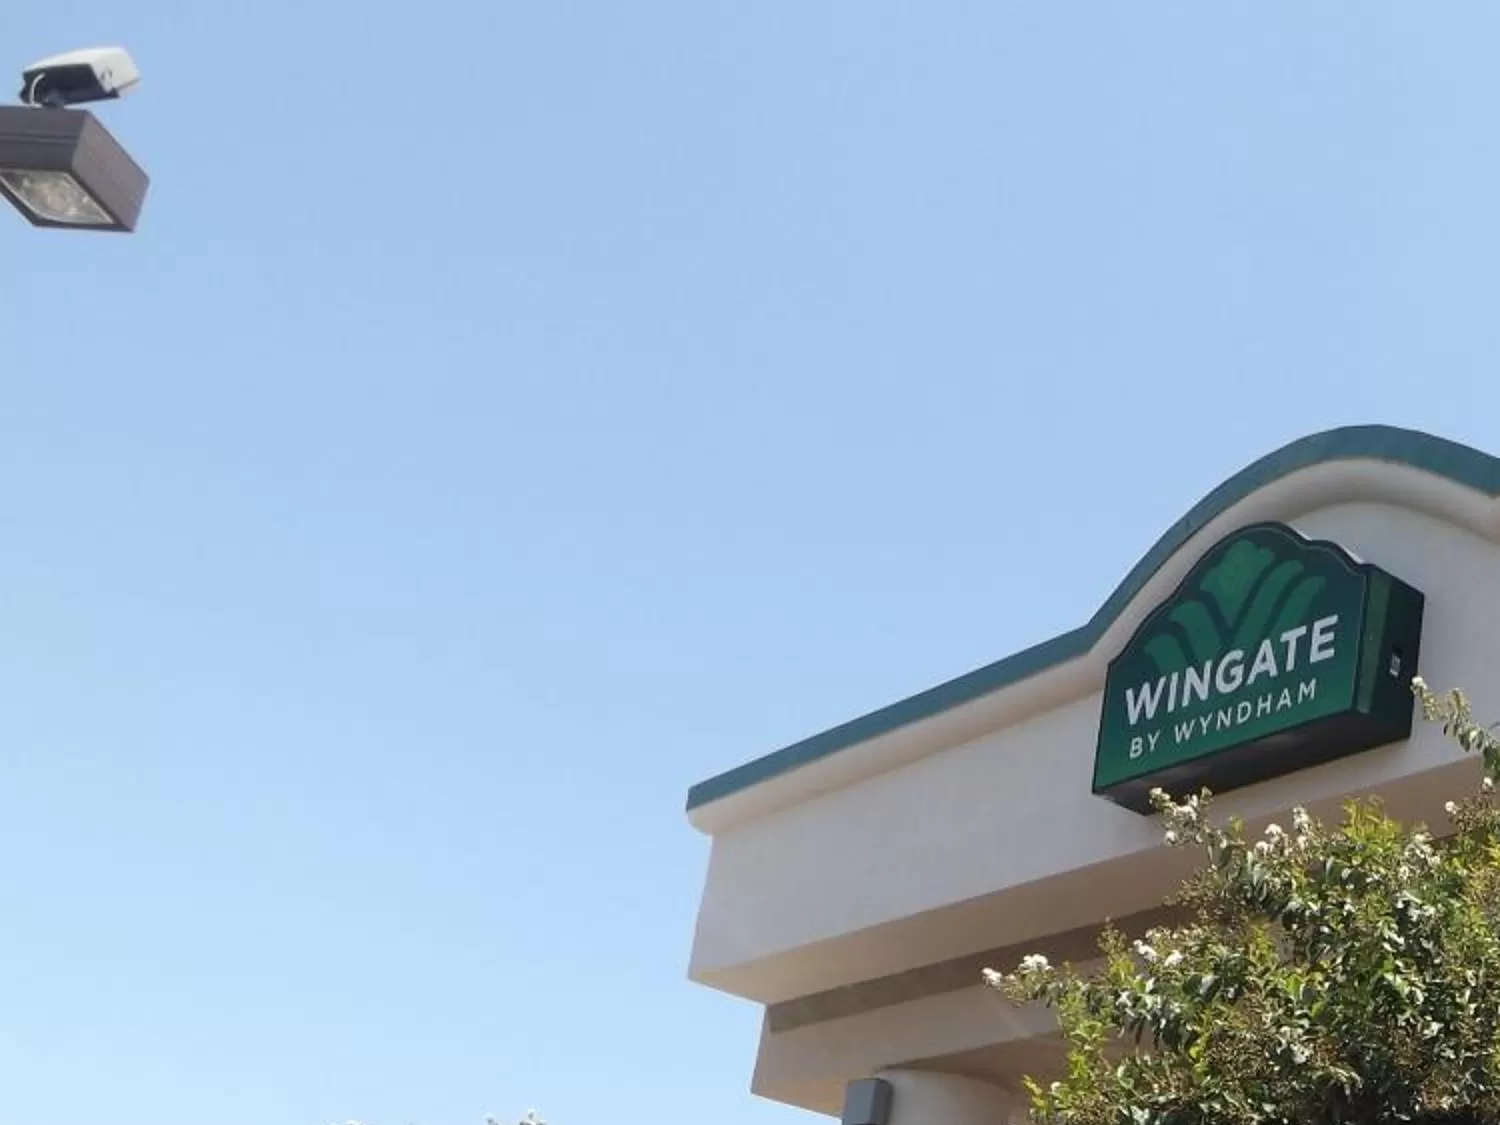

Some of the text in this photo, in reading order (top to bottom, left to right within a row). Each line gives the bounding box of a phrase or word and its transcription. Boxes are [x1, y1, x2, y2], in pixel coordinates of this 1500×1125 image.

[1125, 614, 1339, 725] WINGATE
[1129, 678, 1317, 758] BY WYNDHAM
